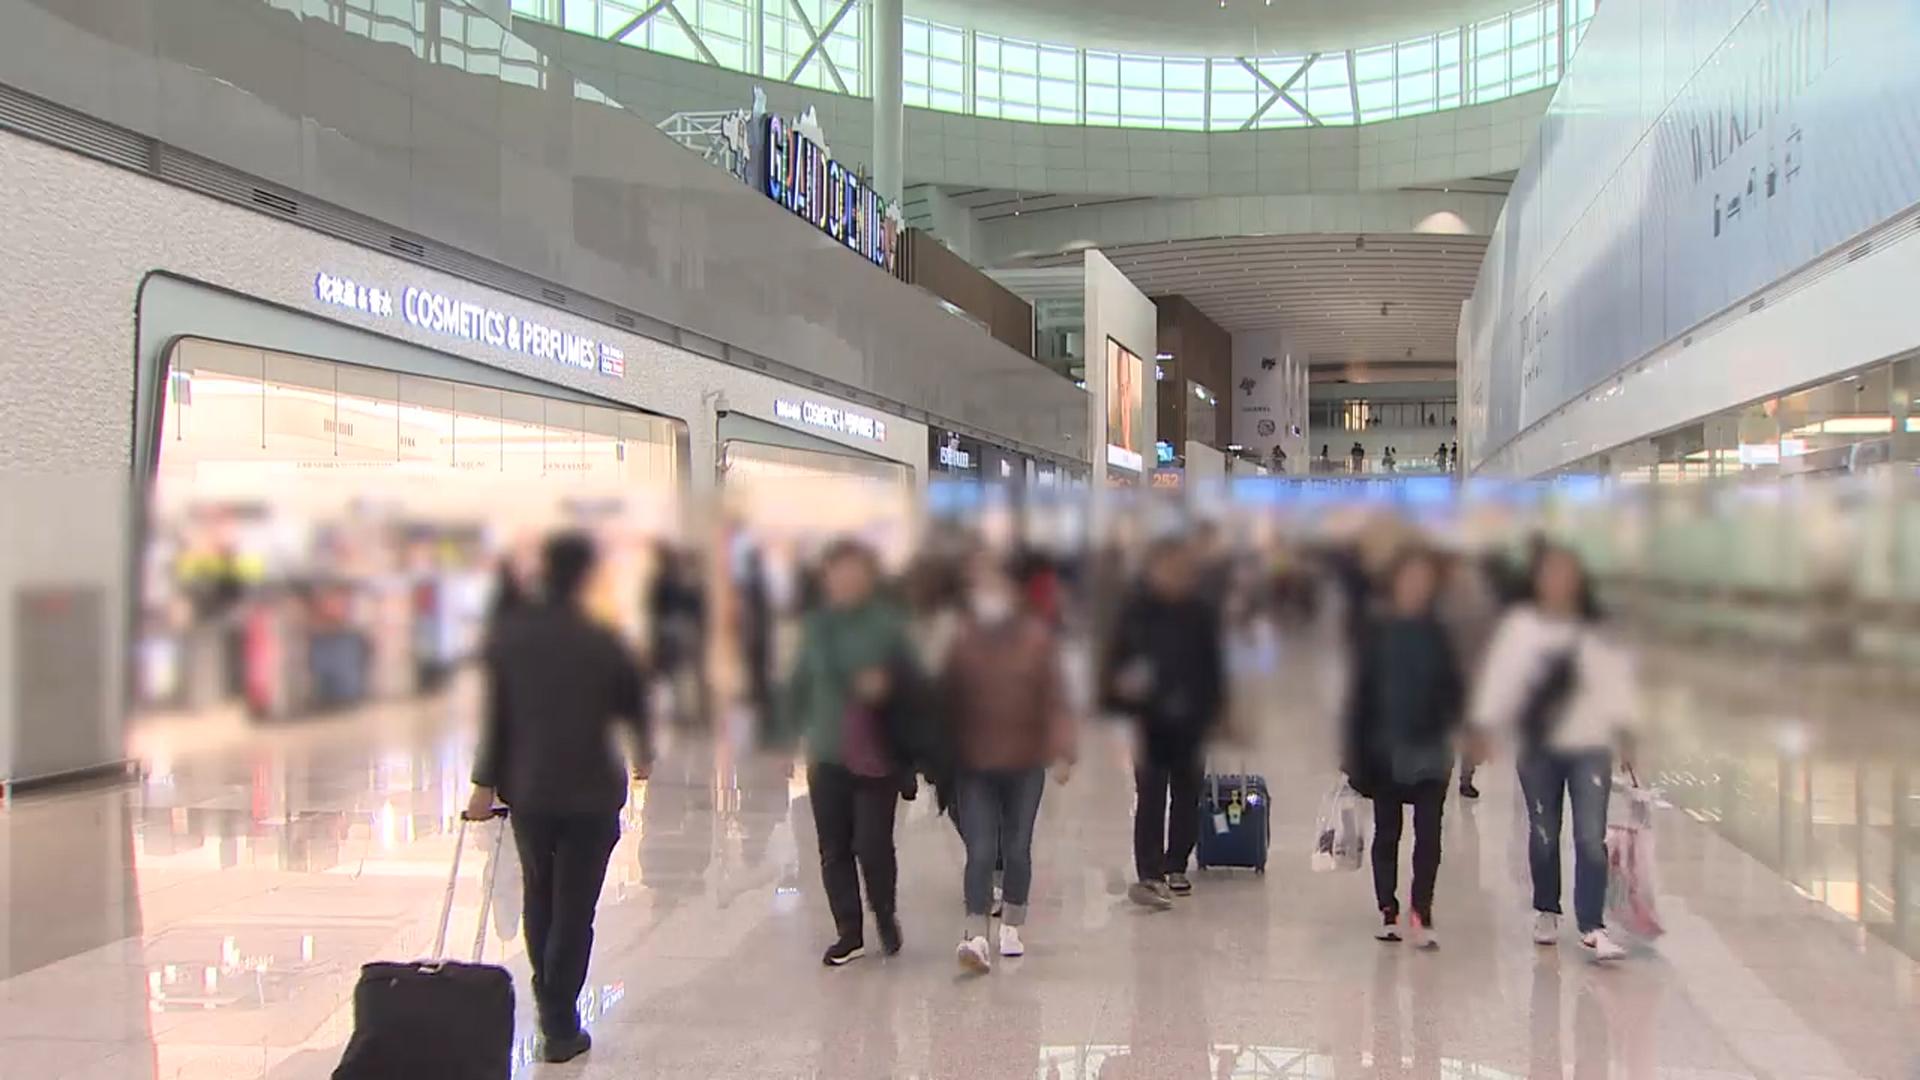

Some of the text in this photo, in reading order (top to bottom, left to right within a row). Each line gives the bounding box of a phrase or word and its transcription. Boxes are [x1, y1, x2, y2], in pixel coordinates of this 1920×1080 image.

[767, 115, 828, 229] GRAND
[403, 286, 504, 346] COSMETICS
[505, 315, 521, 351] &
[522, 319, 595, 369] PERFUMES
